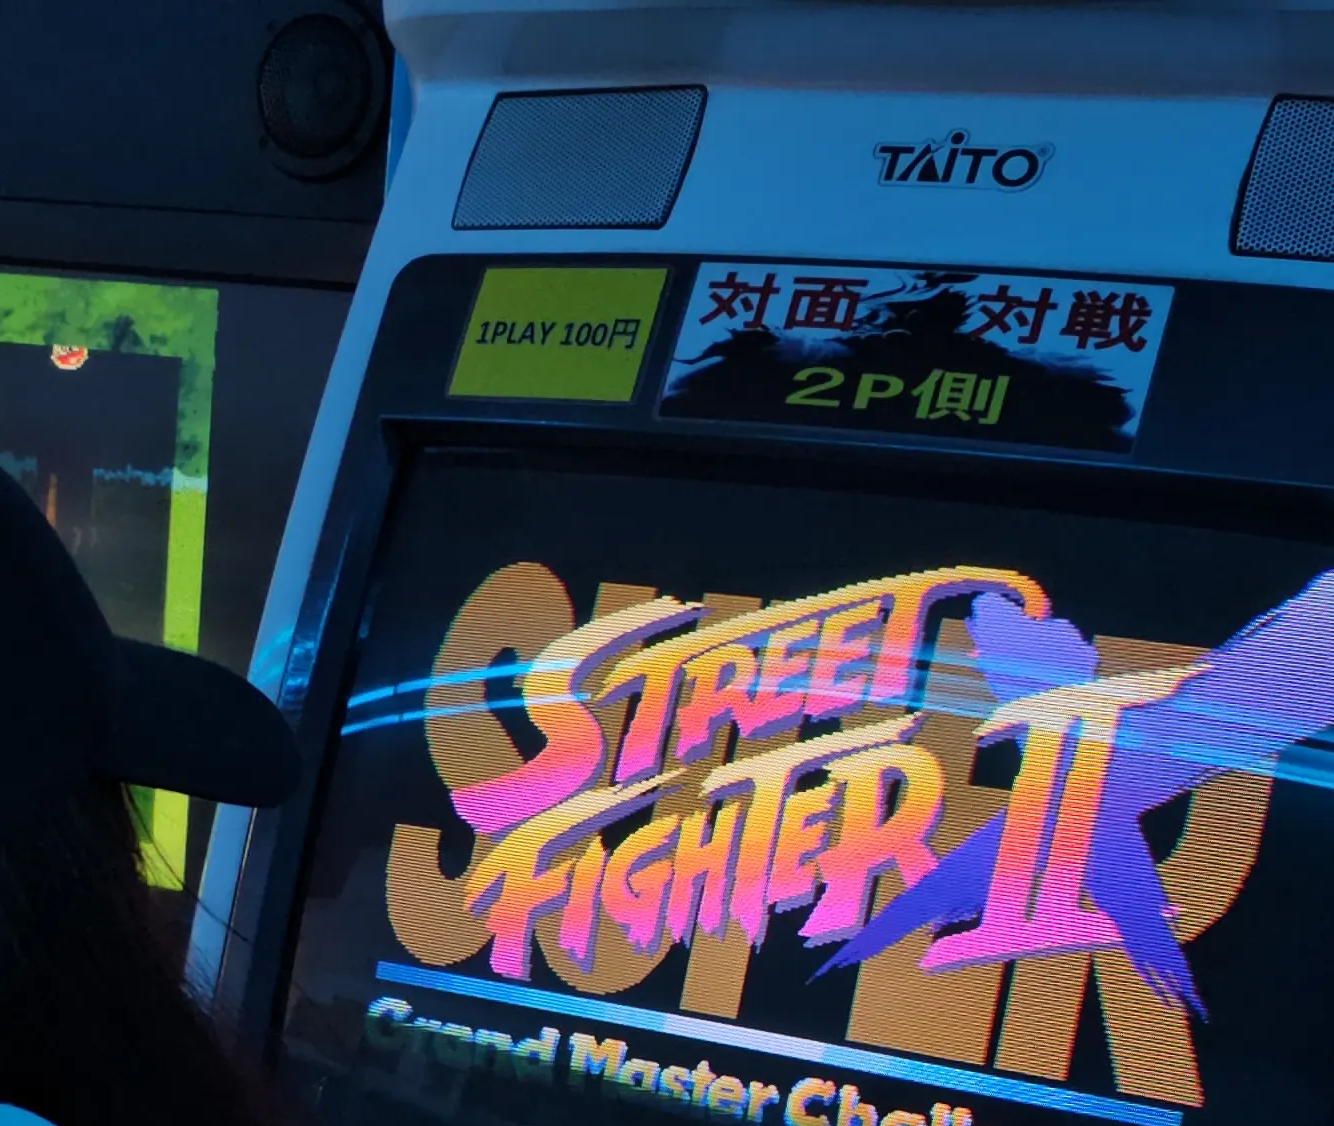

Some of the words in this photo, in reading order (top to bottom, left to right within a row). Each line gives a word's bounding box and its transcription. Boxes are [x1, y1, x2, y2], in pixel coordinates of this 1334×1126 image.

[879, 132, 1038, 187] TAITO
[475, 320, 557, 345] 1PLAY
[560, 318, 641, 349] 100円
[699, 272, 868, 331] 対面
[969, 284, 1152, 352] 対戦
[785, 366, 1010, 425] 2P側
[452, 564, 1051, 834] STREET
[466, 712, 945, 981] FIGHTER
[367, 997, 561, 1078] Grand
[569, 1030, 780, 1123] Master
